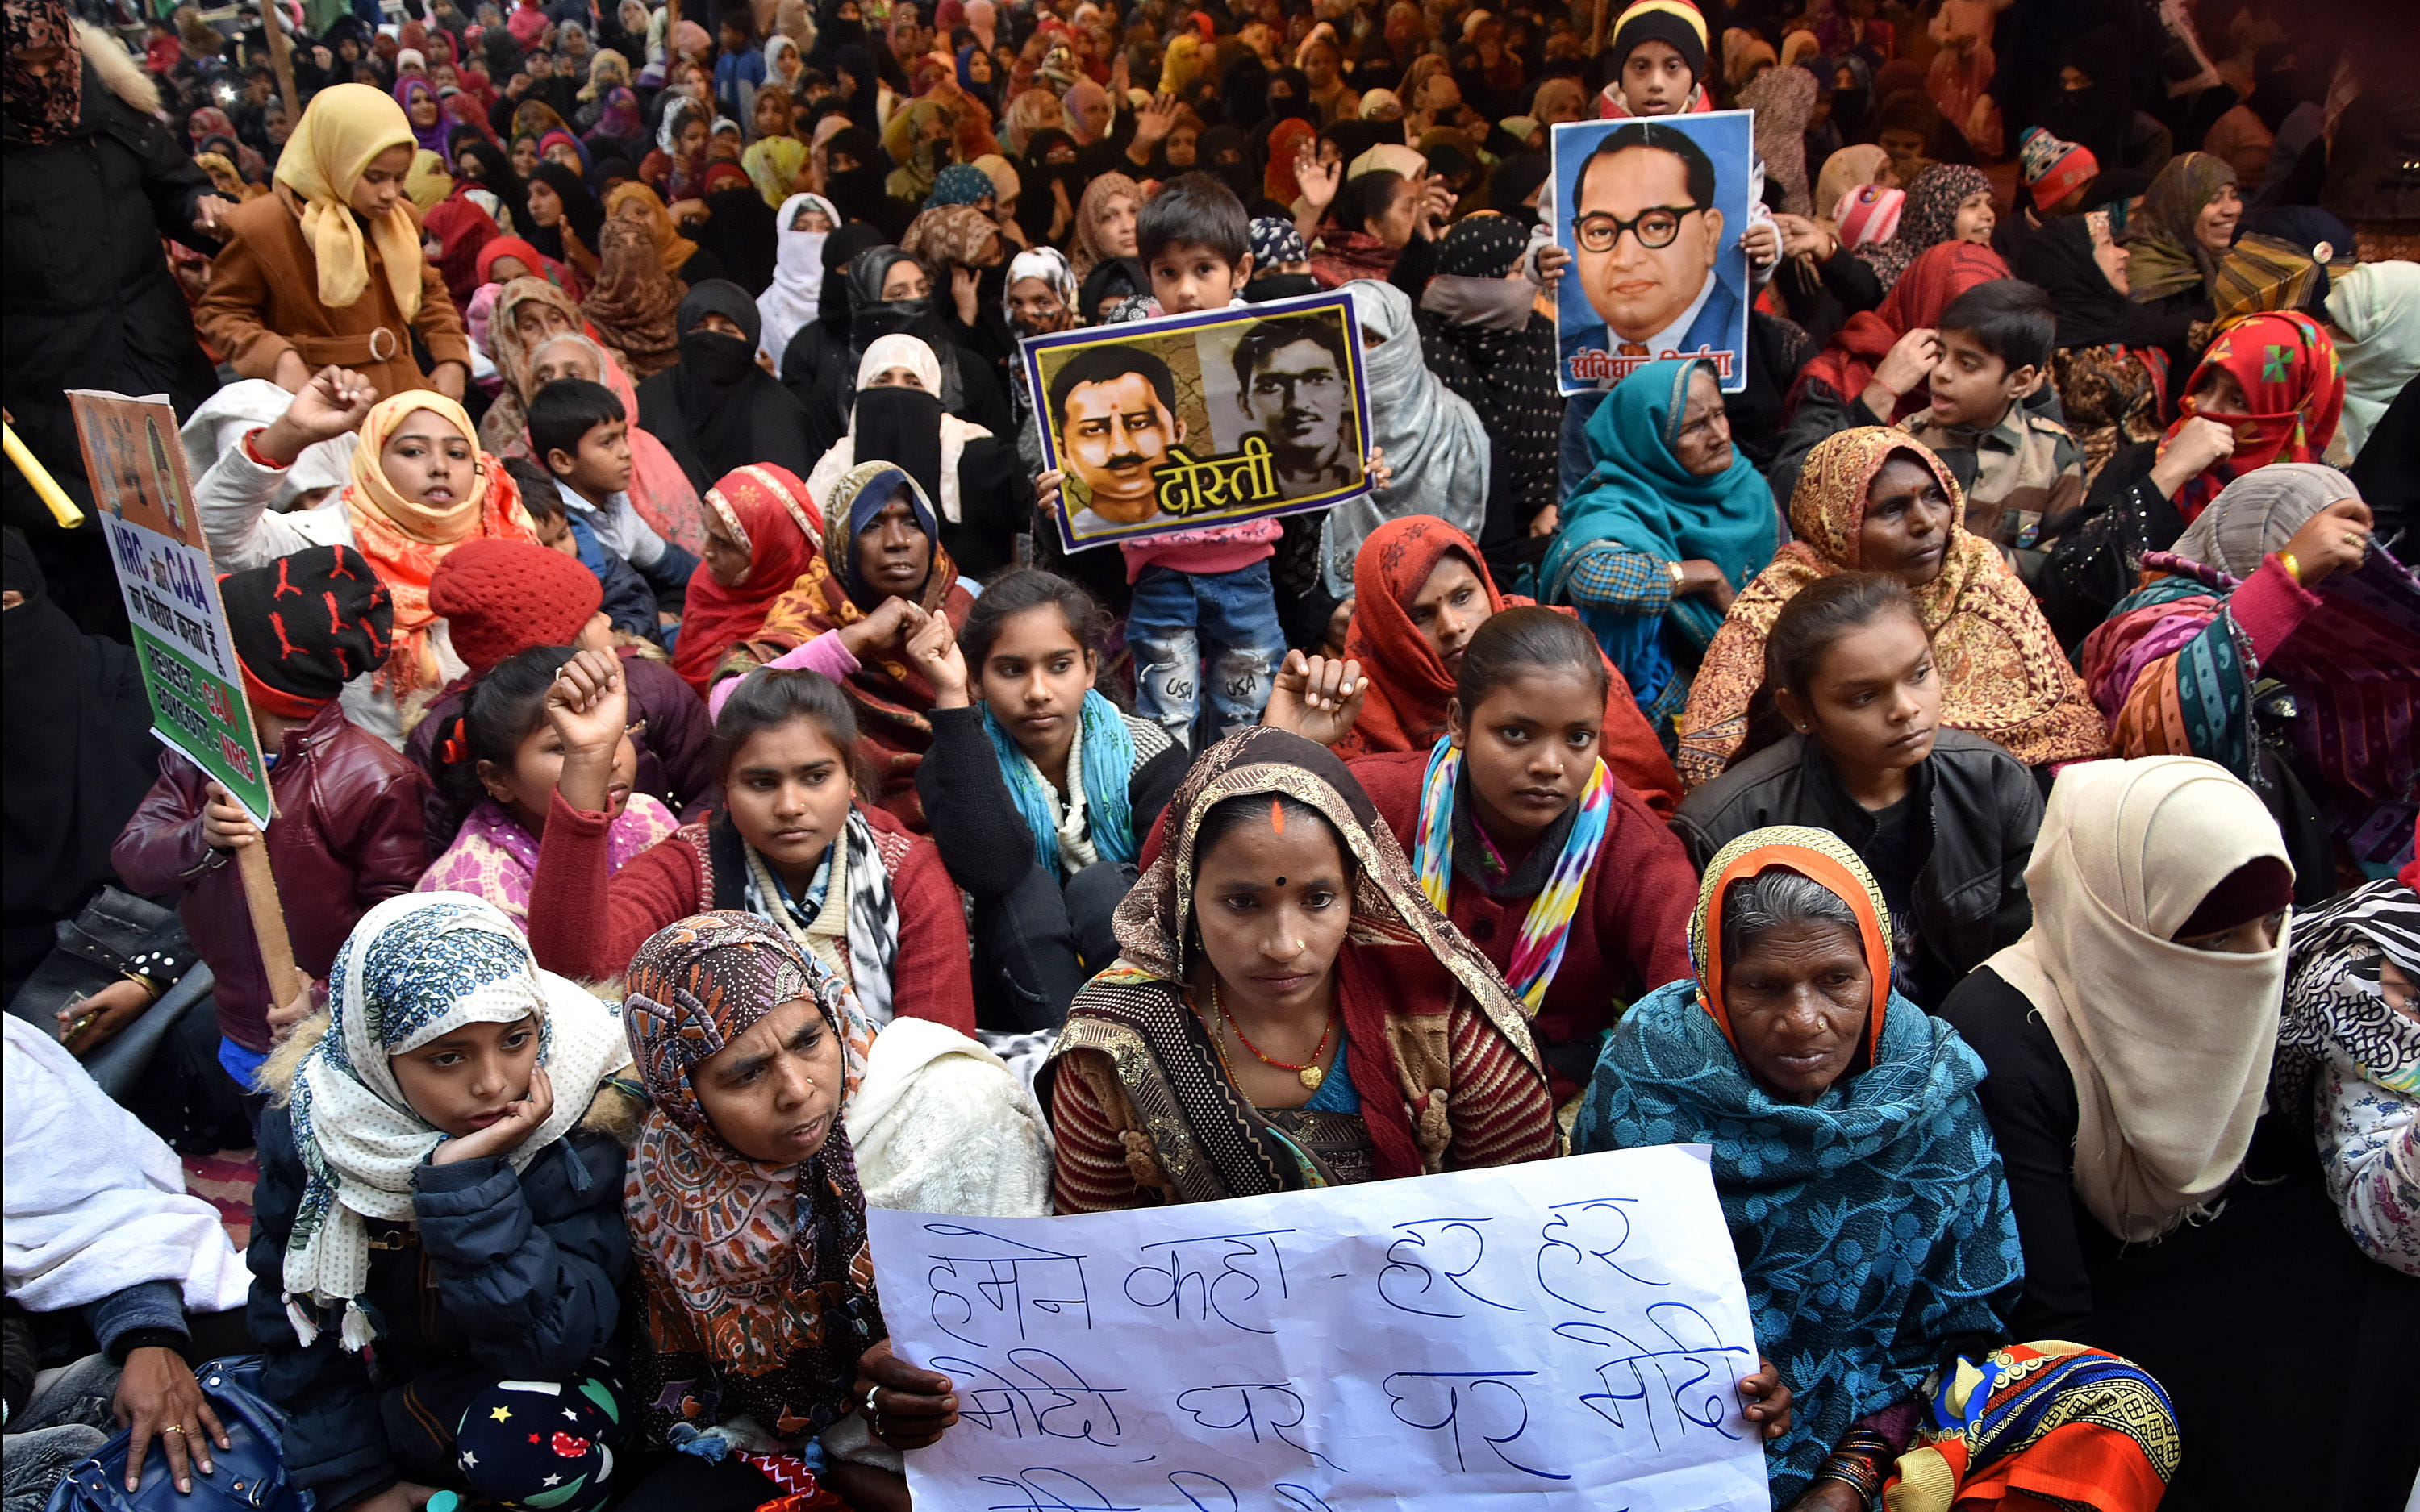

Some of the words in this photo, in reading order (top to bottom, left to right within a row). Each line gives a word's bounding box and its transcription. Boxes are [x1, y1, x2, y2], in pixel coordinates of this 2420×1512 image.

[1154, 436, 1279, 514] दोस्ती
[111, 523, 149, 582] NRC
[165, 546, 211, 614] CAA
[127, 584, 147, 618] का
[141, 585, 177, 635] विरोध
[173, 610, 208, 656] करता
[145, 640, 197, 702] REJECT
[202, 679, 240, 732] CAA
[1166, 677, 1193, 699] USA
[1226, 673, 1256, 696] USA
[152, 680, 213, 751] BOYCOTT
[217, 729, 255, 784] NRC
[924, 1223, 1091, 1348] हमने
[1124, 1228, 1296, 1334] कहा
[1378, 1217, 1528, 1318] हर
[1536, 1198, 1671, 1314] हर
[1176, 1382, 1350, 1473] घर
[1382, 1371, 1572, 1480] घर
[1552, 1301, 1750, 1452] मोदी
